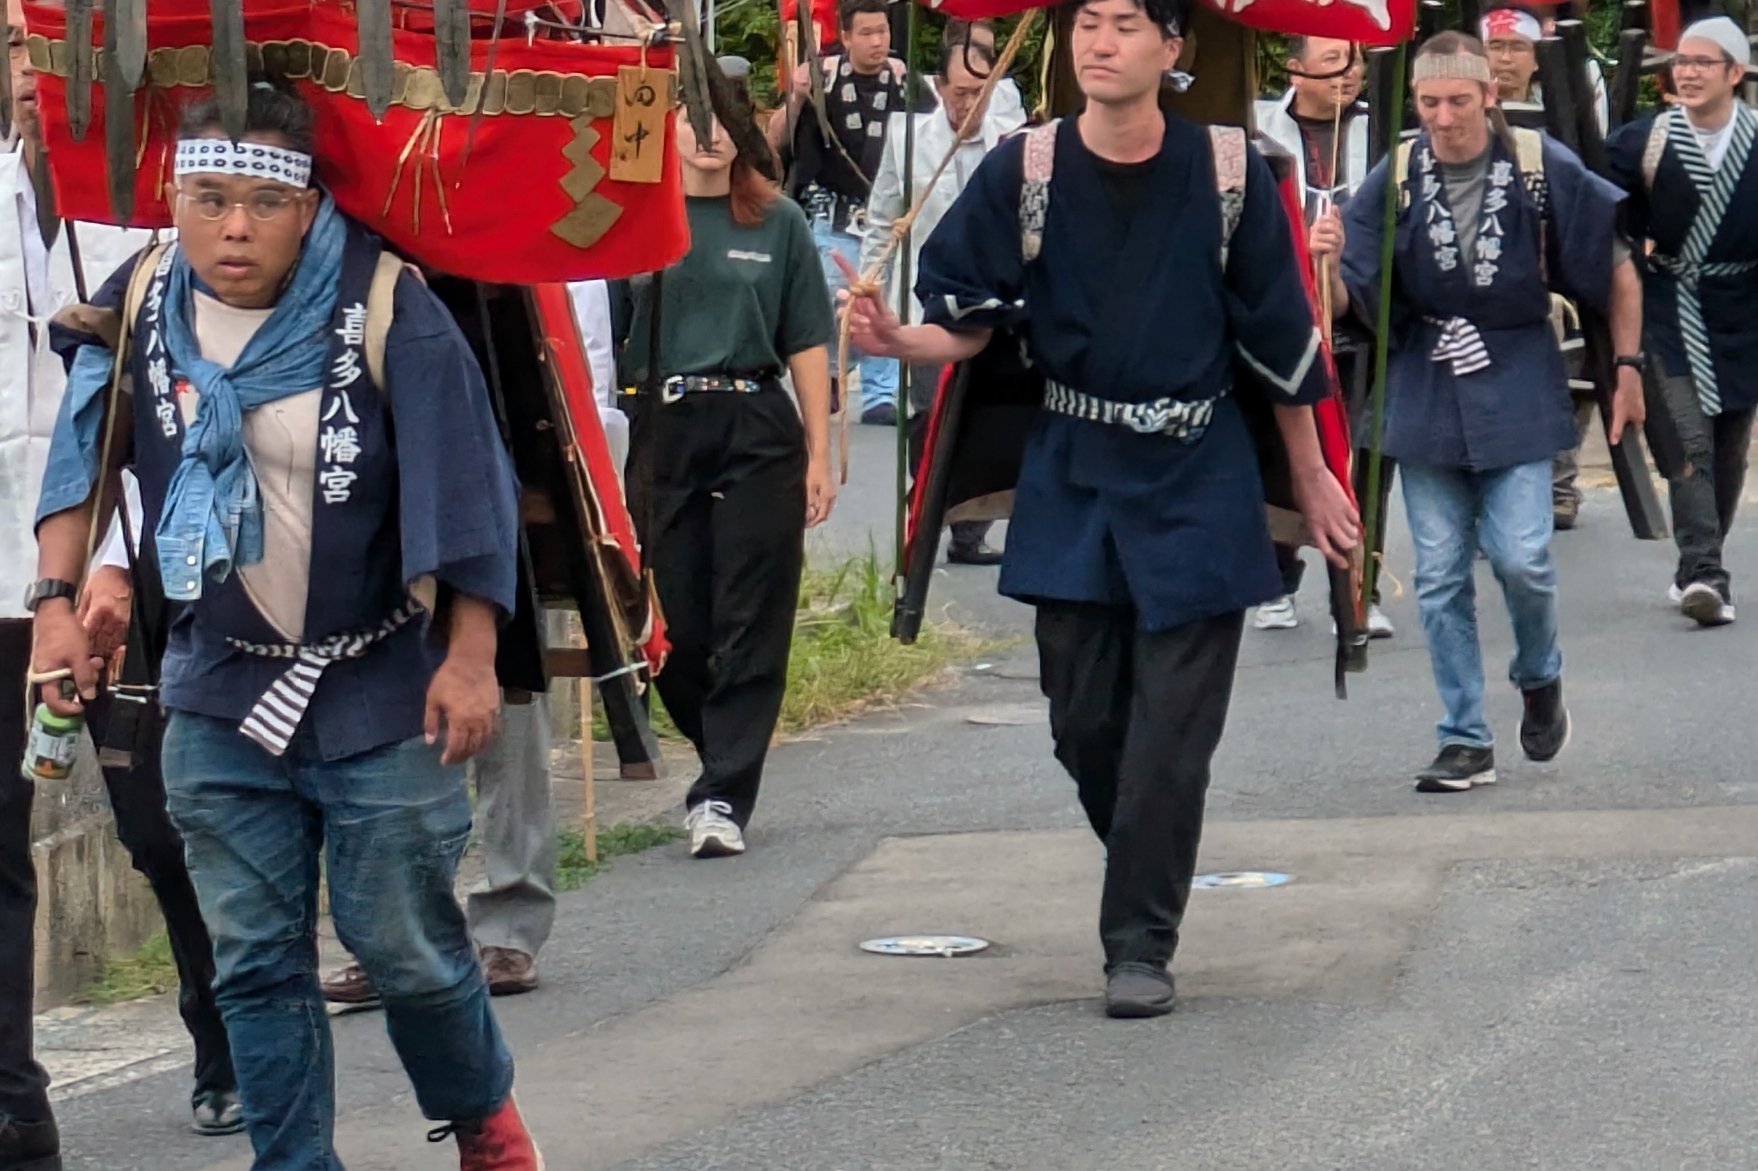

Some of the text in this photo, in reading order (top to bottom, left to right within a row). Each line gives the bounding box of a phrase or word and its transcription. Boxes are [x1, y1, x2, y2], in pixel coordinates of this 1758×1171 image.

[1473, 160, 1514, 286] 喜多八幡宮
[319, 302, 368, 505] 喜多八幡宮
